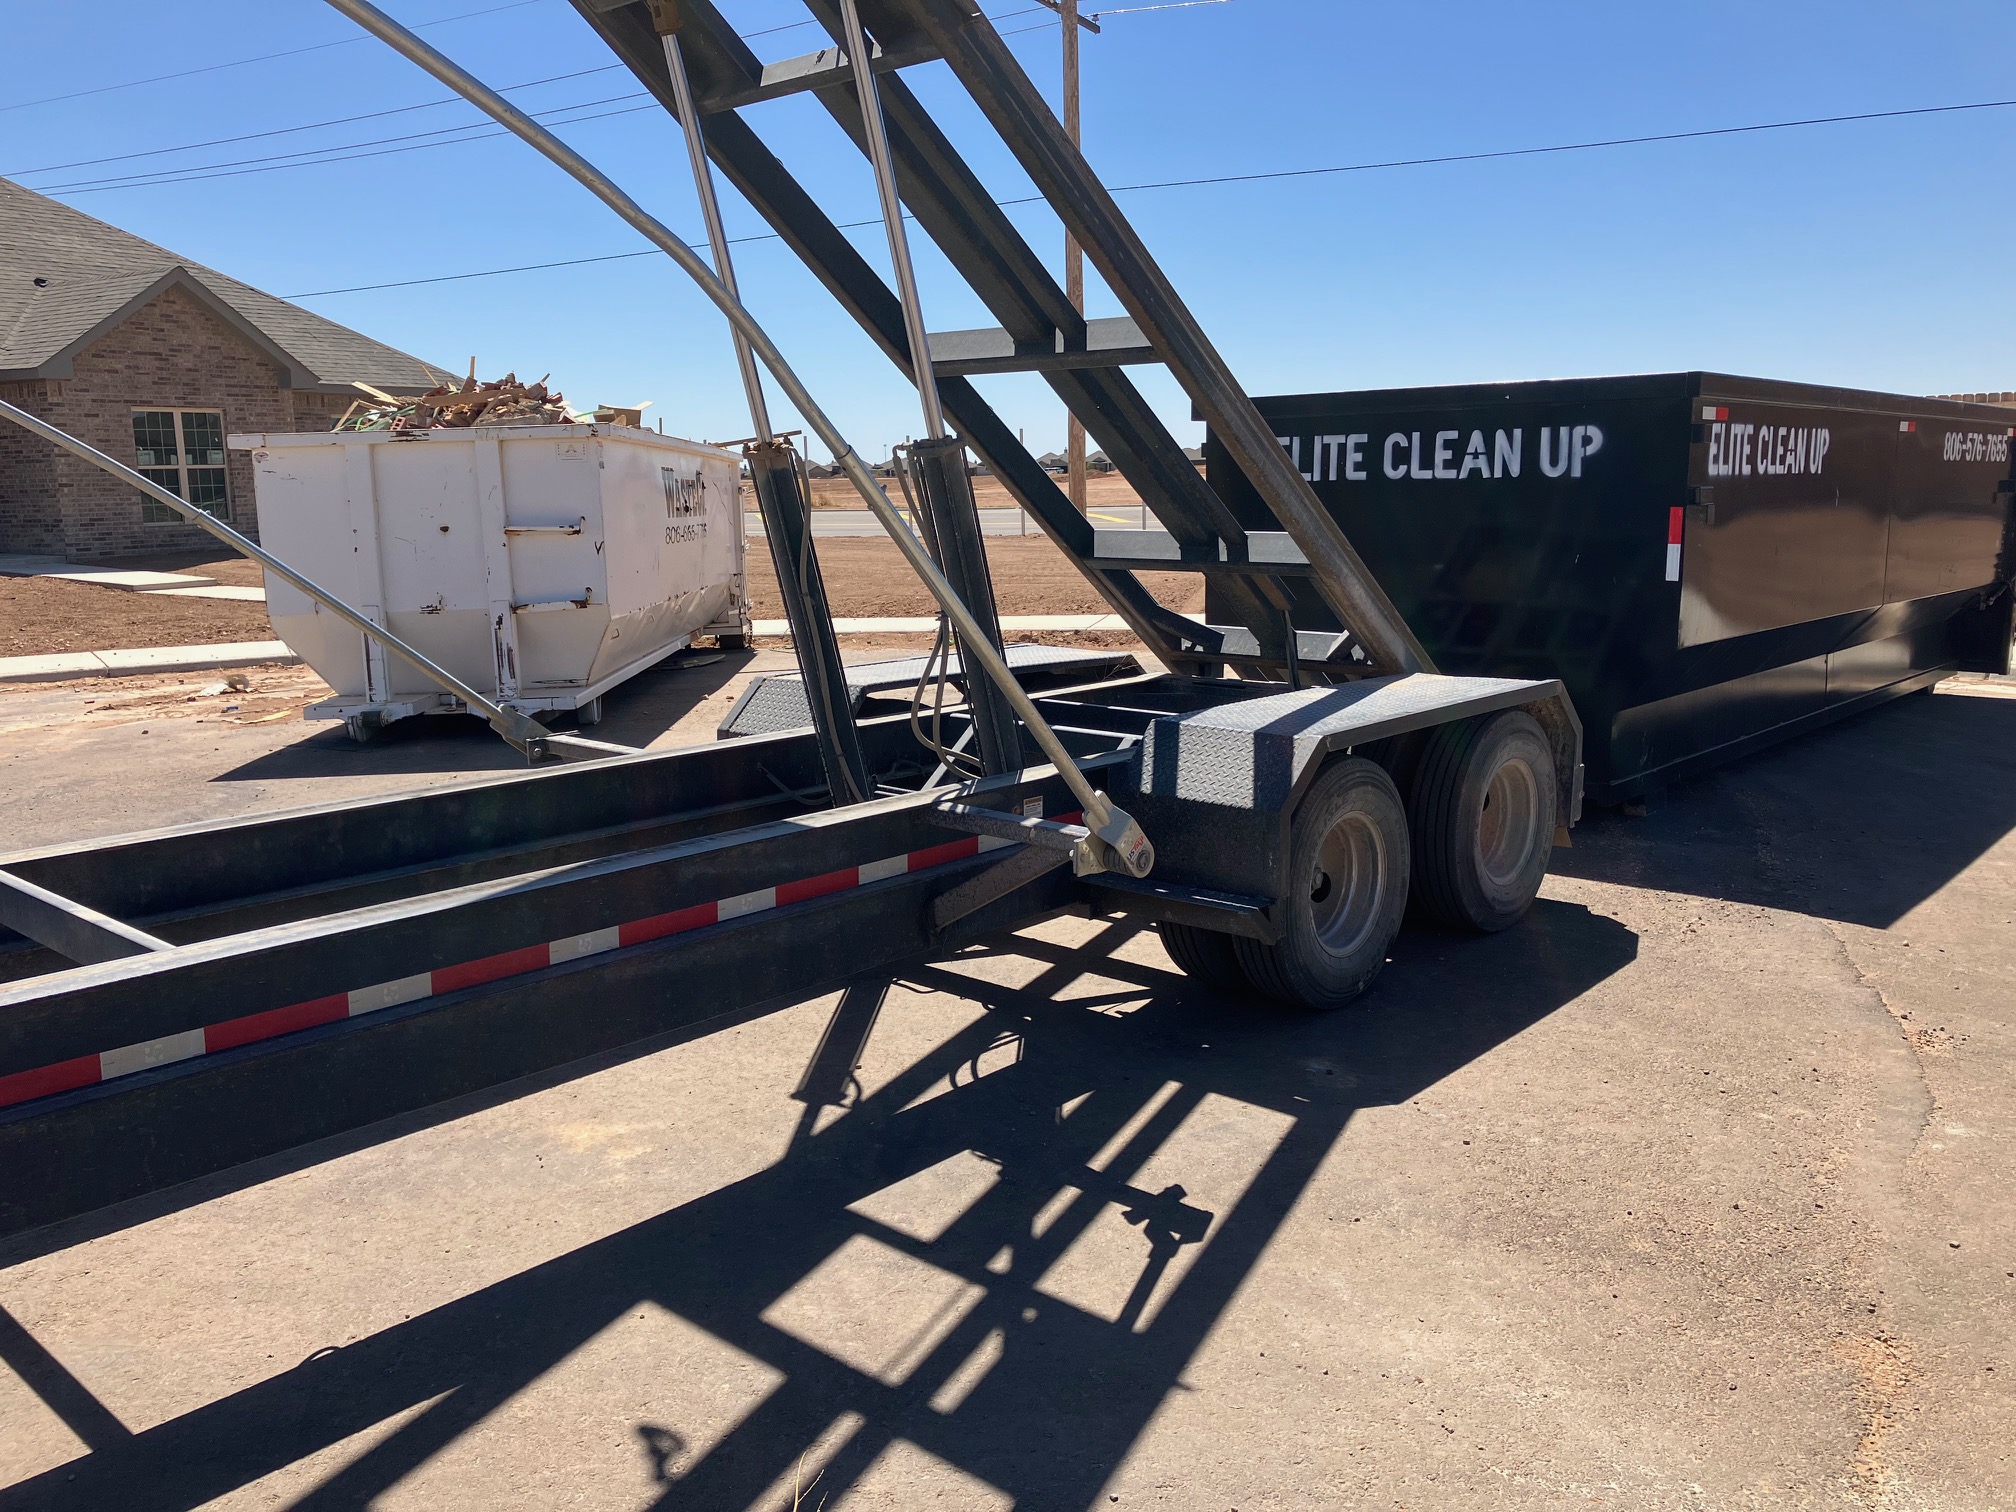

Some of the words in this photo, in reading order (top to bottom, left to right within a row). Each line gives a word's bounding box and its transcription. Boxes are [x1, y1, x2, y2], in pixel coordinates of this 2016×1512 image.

[1383, 427, 1523, 480] CLEAN
[1540, 424, 1604, 478] UP
[1708, 422, 1754, 476] ELITE
[1757, 425, 1808, 475] CLEAN
[1809, 427, 1830, 475] UP
[1943, 431, 2008, 462] 806-576-7655
